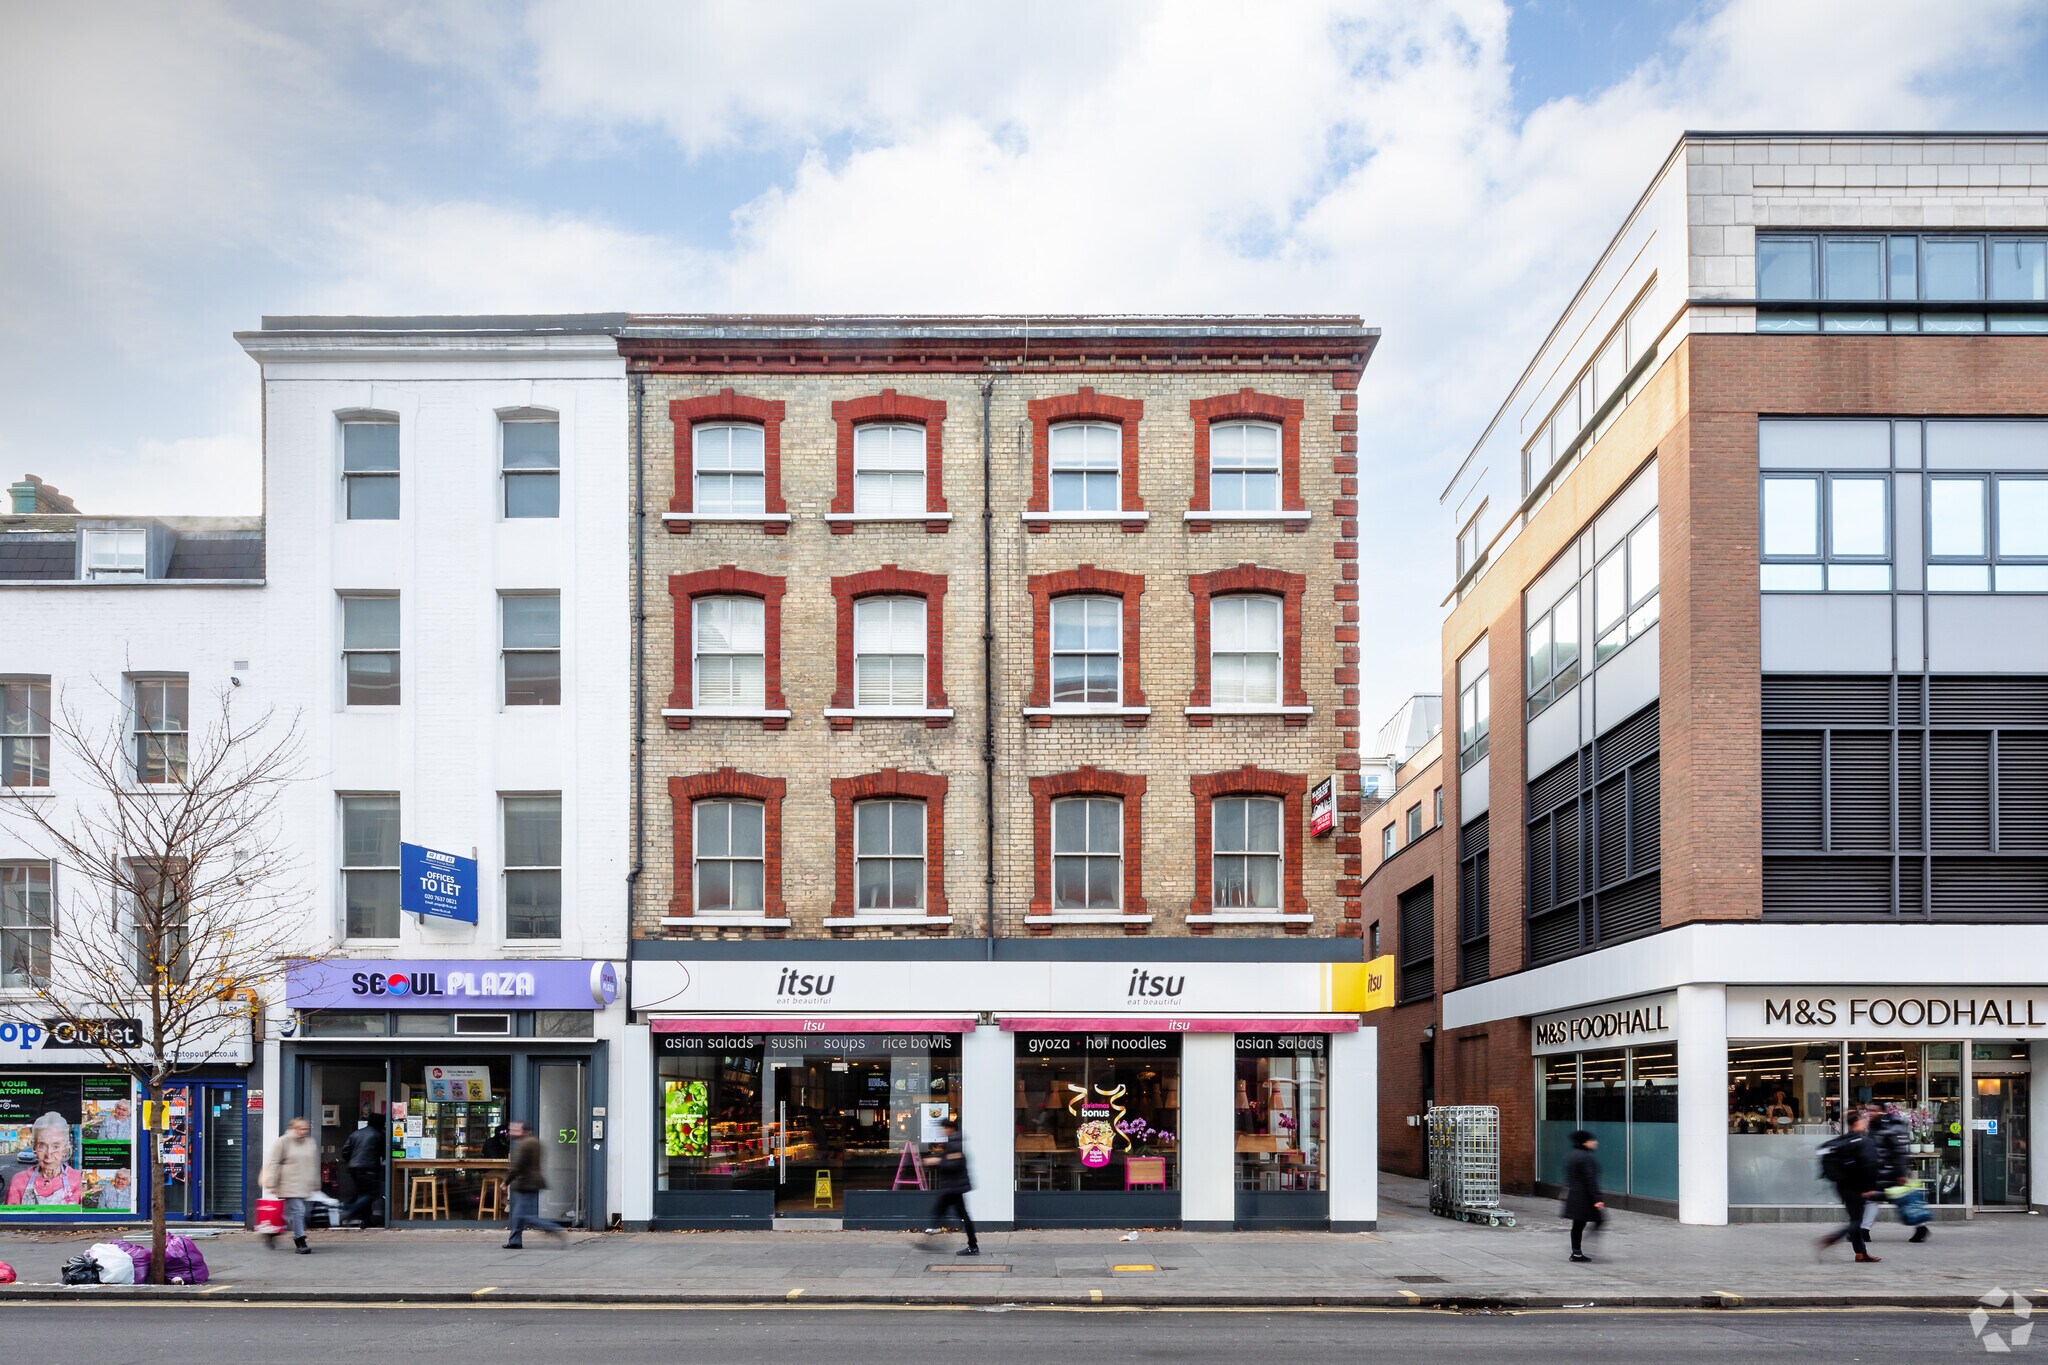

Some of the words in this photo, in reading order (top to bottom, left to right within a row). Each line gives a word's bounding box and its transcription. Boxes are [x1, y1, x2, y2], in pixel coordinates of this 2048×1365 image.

[427, 871, 455, 883] OFFICES
[420, 877, 438, 892] TO
[441, 882, 461, 897] LET
[352, 972, 444, 996] SEOUL
[447, 971, 535, 996] PLAZA
[777, 967, 835, 996] itsu
[1128, 968, 1186, 997] itsu
[1367, 973, 1383, 993] itsu
[792, 997, 832, 1005] beautiful
[1143, 998, 1182, 1006] beautiful
[1764, 998, 1837, 1026] M&S
[1849, 998, 2047, 1026] FOODHALL
[803, 1019, 825, 1031] itsu
[1168, 1020, 1190, 1031] itsu
[1536, 1021, 1567, 1046] M&S
[1571, 1005, 1669, 1042] FOODHALL
[665, 1036, 704, 1049] asian
[708, 1035, 754, 1049] salads
[771, 1035, 808, 1049] sushi
[823, 1037, 866, 1052] soups
[882, 1036, 907, 1049] rice
[911, 1035, 952, 1049] bowls
[1028, 1038, 1070, 1052] gyoza
[1086, 1036, 1110, 1050] hot
[1111, 1036, 1167, 1050] noodles
[1235, 1037, 1273, 1050] asian
[1277, 1036, 1324, 1050] salads
[1082, 1108, 1109, 1117] bonus
[558, 1129, 578, 1144] 52
